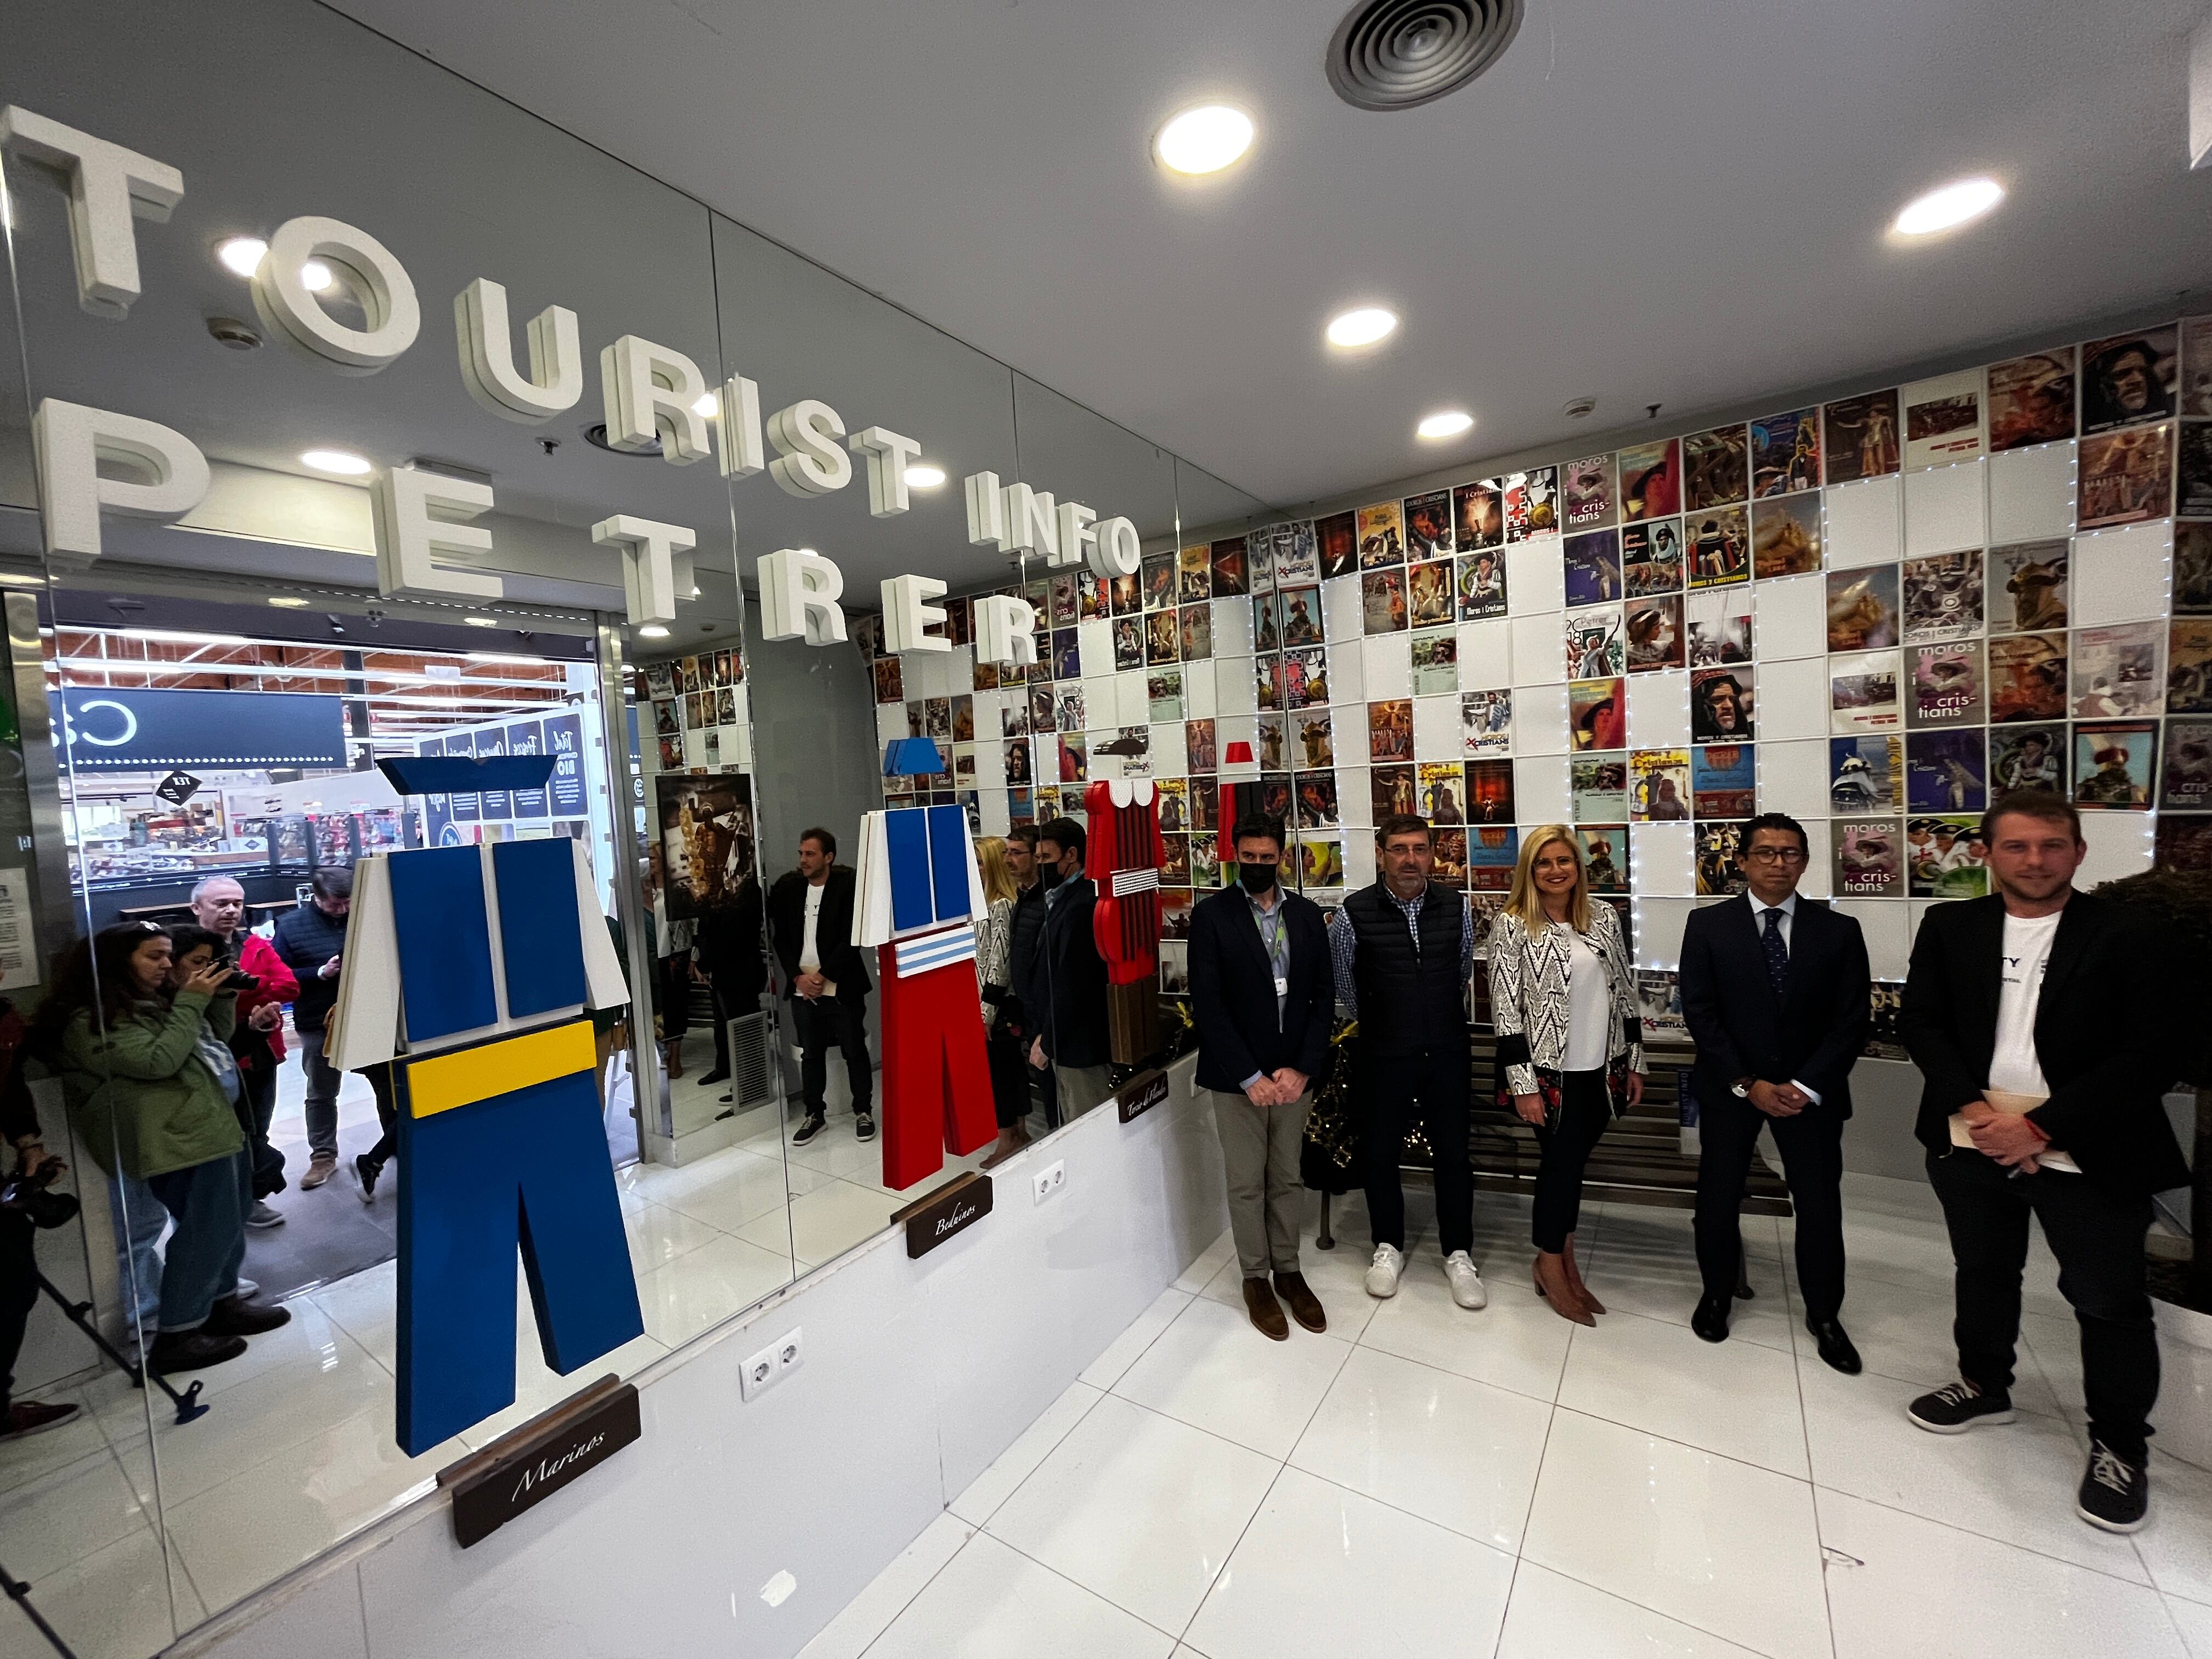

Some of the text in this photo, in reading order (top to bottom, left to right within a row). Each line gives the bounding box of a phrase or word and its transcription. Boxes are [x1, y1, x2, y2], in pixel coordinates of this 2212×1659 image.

[2, 104, 1141, 579] TOURIST INFO
[1568, 455, 1608, 471] moros
[1569, 511, 1600, 524] tians
[33, 396, 1038, 667] PETRER
[1918, 642, 1976, 657] moros
[1912, 673, 1916, 685] i
[1937, 692, 1977, 707] cris-
[1918, 705, 1961, 718] tians
[1843, 823, 1896, 833] moros
[1838, 847, 1842, 860] i
[1861, 869, 1897, 882] cris-
[1844, 879, 1884, 891] tians
[935, 1201, 975, 1236] Beduinos
[511, 1432, 605, 1502] Marinos
